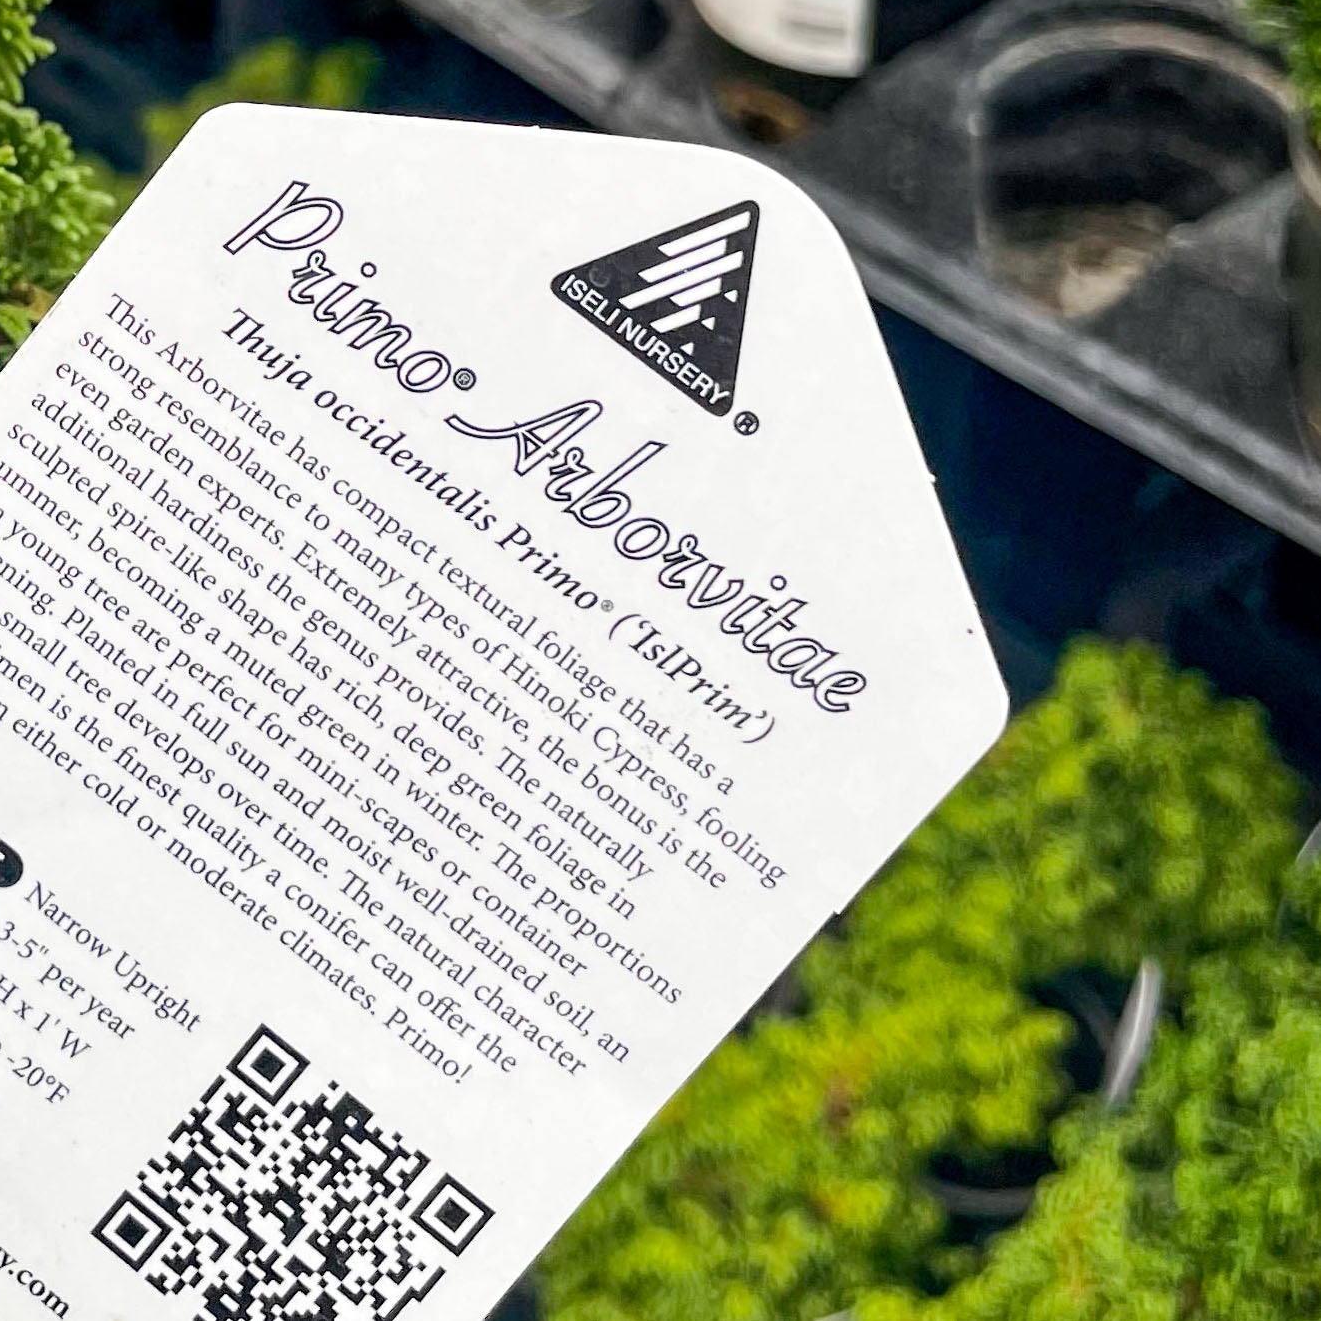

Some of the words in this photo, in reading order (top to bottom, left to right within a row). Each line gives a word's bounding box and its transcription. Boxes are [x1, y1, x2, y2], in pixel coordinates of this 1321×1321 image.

[105, 292, 156, 346] This
[154, 341, 286, 447] Arborvitae
[285, 435, 331, 482] has
[332, 479, 438, 564] compact
[438, 557, 538, 639] textural
[533, 630, 617, 703] foliage
[618, 697, 671, 745] that
[668, 732, 716, 779] has
[716, 776, 734, 796] a
[221, 307, 313, 391] Thuja
[313, 390, 498, 532] occidentalis
[560, 274, 621, 326] ISELI
[616, 316, 731, 405] NURSERY
[2, 519, 83, 589] young
[84, 577, 130, 622] tree
[131, 619, 171, 653] are
[165, 648, 258, 720] perfect
[255, 712, 297, 749] for
[294, 746, 439, 863] mini-scapes
[440, 860, 472, 886] or
[472, 885, 588, 977] container
[7, 423, 111, 506] sculpted
[106, 501, 217, 591] spire-like
[217, 588, 288, 646] shape
[287, 635, 333, 681] has
[332, 677, 385, 729] rich,
[393, 722, 452, 777] deep
[448, 772, 522, 832] green
[523, 823, 607, 896] foliage
[607, 887, 636, 921] in
[31, 393, 155, 491] additional
[149, 478, 264, 579] hardiness
[266, 572, 307, 612] the
[302, 609, 379, 668] genus
[373, 664, 485, 756] provides.
[495, 745, 541, 795] The
[541, 791, 655, 882] naturally
[55, 363, 110, 412] even
[107, 408, 194, 478] garden
[197, 474, 285, 551] experts.
[290, 540, 418, 648] Extremely
[415, 643, 529, 743] attractive,
[537, 734, 579, 774] the
[580, 763, 658, 835] bonus
[657, 827, 683, 855] is
[684, 849, 727, 889] the
[78, 331, 157, 401] strong
[155, 391, 302, 510] resemblance
[304, 503, 331, 531] to
[331, 528, 405, 589] many
[404, 581, 470, 639] types
[472, 637, 510, 663] of
[499, 652, 593, 734] Hinoki
[593, 726, 688, 816] Cypress,
[694, 806, 787, 889] fooling
[87, 526, 205, 635] becoming
[204, 627, 221, 646] a
[222, 640, 307, 707] muted
[297, 703, 371, 762] green
[372, 753, 401, 786] in
[405, 779, 484, 852] winter.
[491, 841, 537, 890] The
[531, 886, 682, 1004] proportions
[442, 399, 868, 714] Arborvitae
[12, 718, 83, 775] either
[82, 773, 140, 818] cold
[136, 815, 167, 840] or
[164, 838, 278, 931] moderate
[279, 930, 377, 1016] climates.
[382, 1006, 473, 1084] Primo!
[13, 999, 34, 1021] x
[60, 1027, 92, 1059] W
[24, 880, 112, 958] Narrow
[114, 950, 201, 1033] Upright
[37, 963, 86, 1000] per
[79, 995, 136, 1040] year
[47, 694, 72, 721] is
[74, 714, 113, 753] the
[113, 746, 182, 806] finest
[182, 803, 267, 873] quality
[265, 868, 282, 888] a
[284, 884, 371, 954] conifer
[370, 953, 414, 993] can
[417, 989, 476, 1038] offer
[476, 1032, 517, 1073] the
[60, 605, 157, 687] Planted
[151, 678, 179, 711] in
[180, 701, 230, 745] full
[225, 741, 271, 782] sun
[272, 778, 326, 820] and
[320, 815, 393, 875] moist
[395, 869, 548, 994] well-drained
[543, 990, 595, 1037] soil,
[597, 1033, 630, 1064] an
[65, 659, 112, 704] tree
[113, 698, 216, 785] develops
[217, 782, 273, 828] over
[272, 822, 329, 879] time.
[338, 868, 384, 917] The
[383, 914, 477, 988] natural
[474, 985, 587, 1076] character
